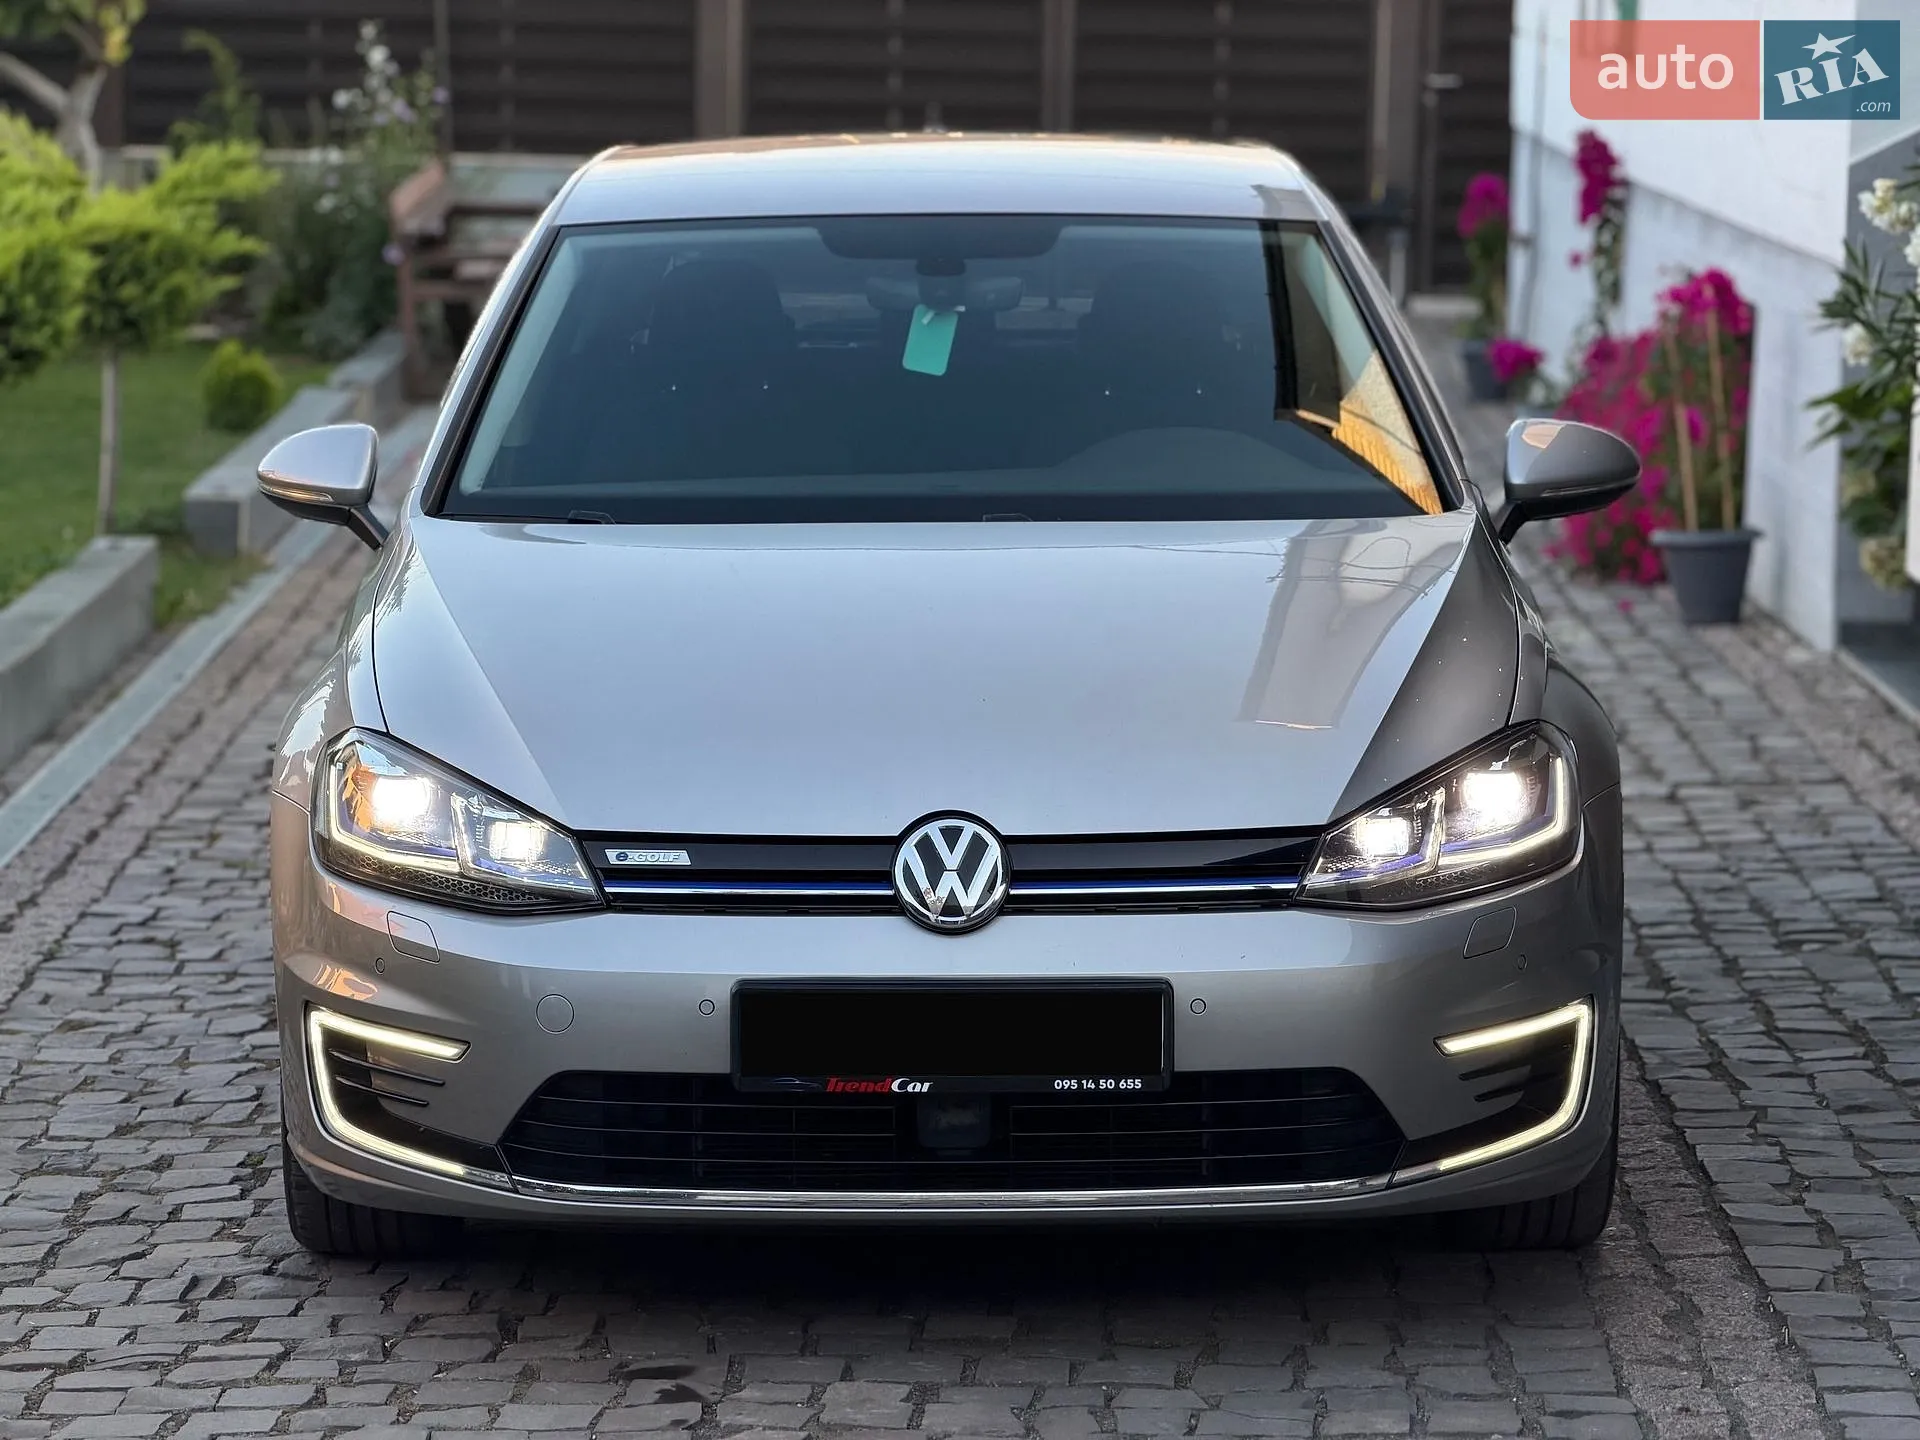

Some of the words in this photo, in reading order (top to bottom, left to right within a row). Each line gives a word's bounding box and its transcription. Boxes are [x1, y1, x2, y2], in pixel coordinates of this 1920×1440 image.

[825, 1076, 934, 1093] TrendCar
[1054, 1079, 1078, 1090] 095
[1081, 1079, 1096, 1090] 14
[1098, 1079, 1116, 1090] 50
[1118, 1078, 1142, 1090] 655
